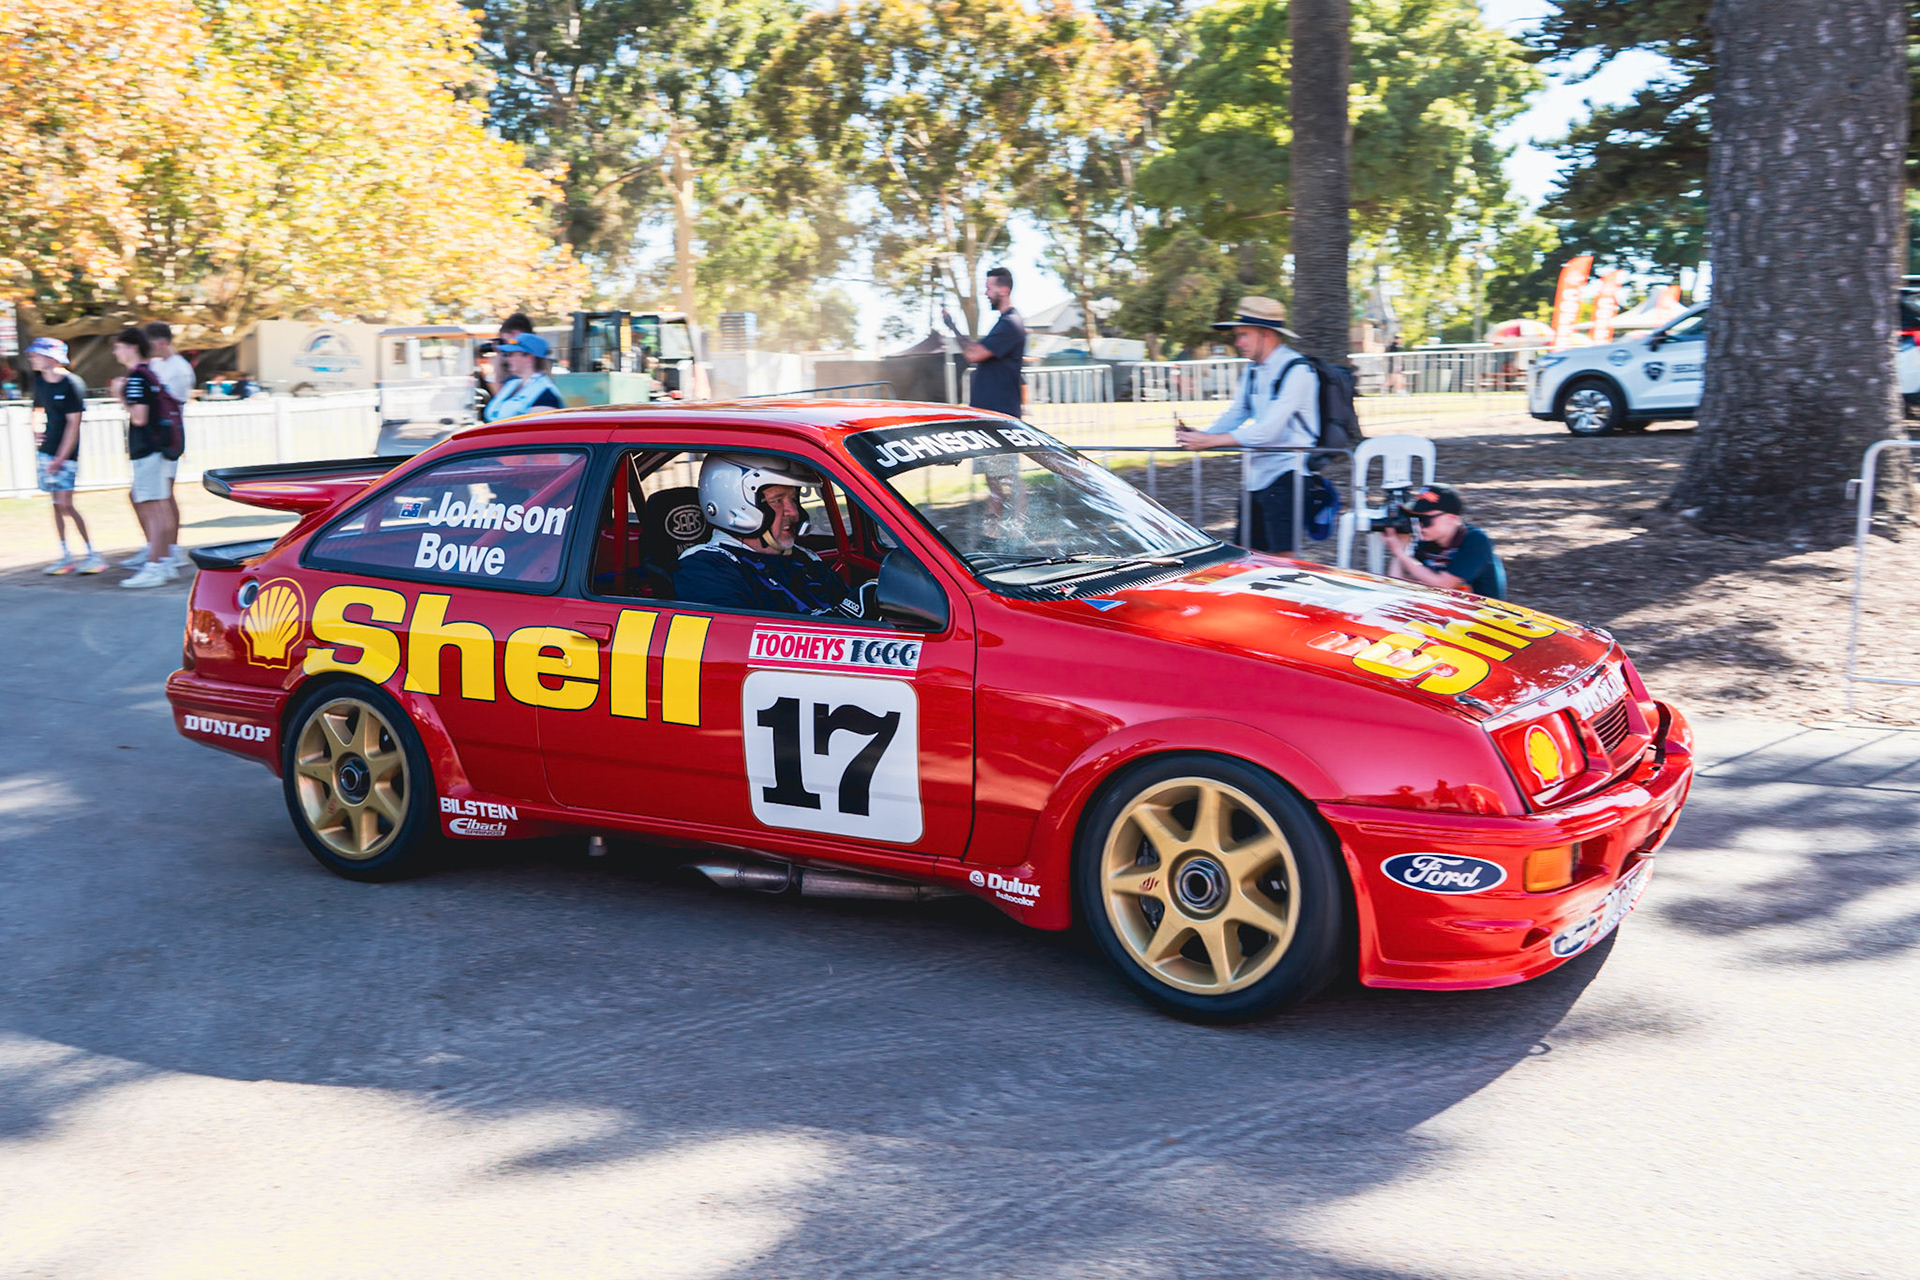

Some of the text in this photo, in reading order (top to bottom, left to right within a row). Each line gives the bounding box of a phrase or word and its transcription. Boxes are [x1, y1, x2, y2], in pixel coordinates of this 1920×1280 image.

[876, 428, 1069, 468] JOHNSON BOW
[428, 492, 567, 536] Johnson
[414, 532, 506, 576] Bowe
[301, 584, 714, 728] Shell
[756, 633, 920, 667] TOOHEYS 1000
[184, 714, 271, 742] DUNLOP
[757, 696, 901, 817] 17
[440, 796, 518, 820] BILSTEIN
[449, 817, 508, 836] Eibach
[987, 872, 1041, 897] Dulux
[1403, 855, 1483, 888] Ford
